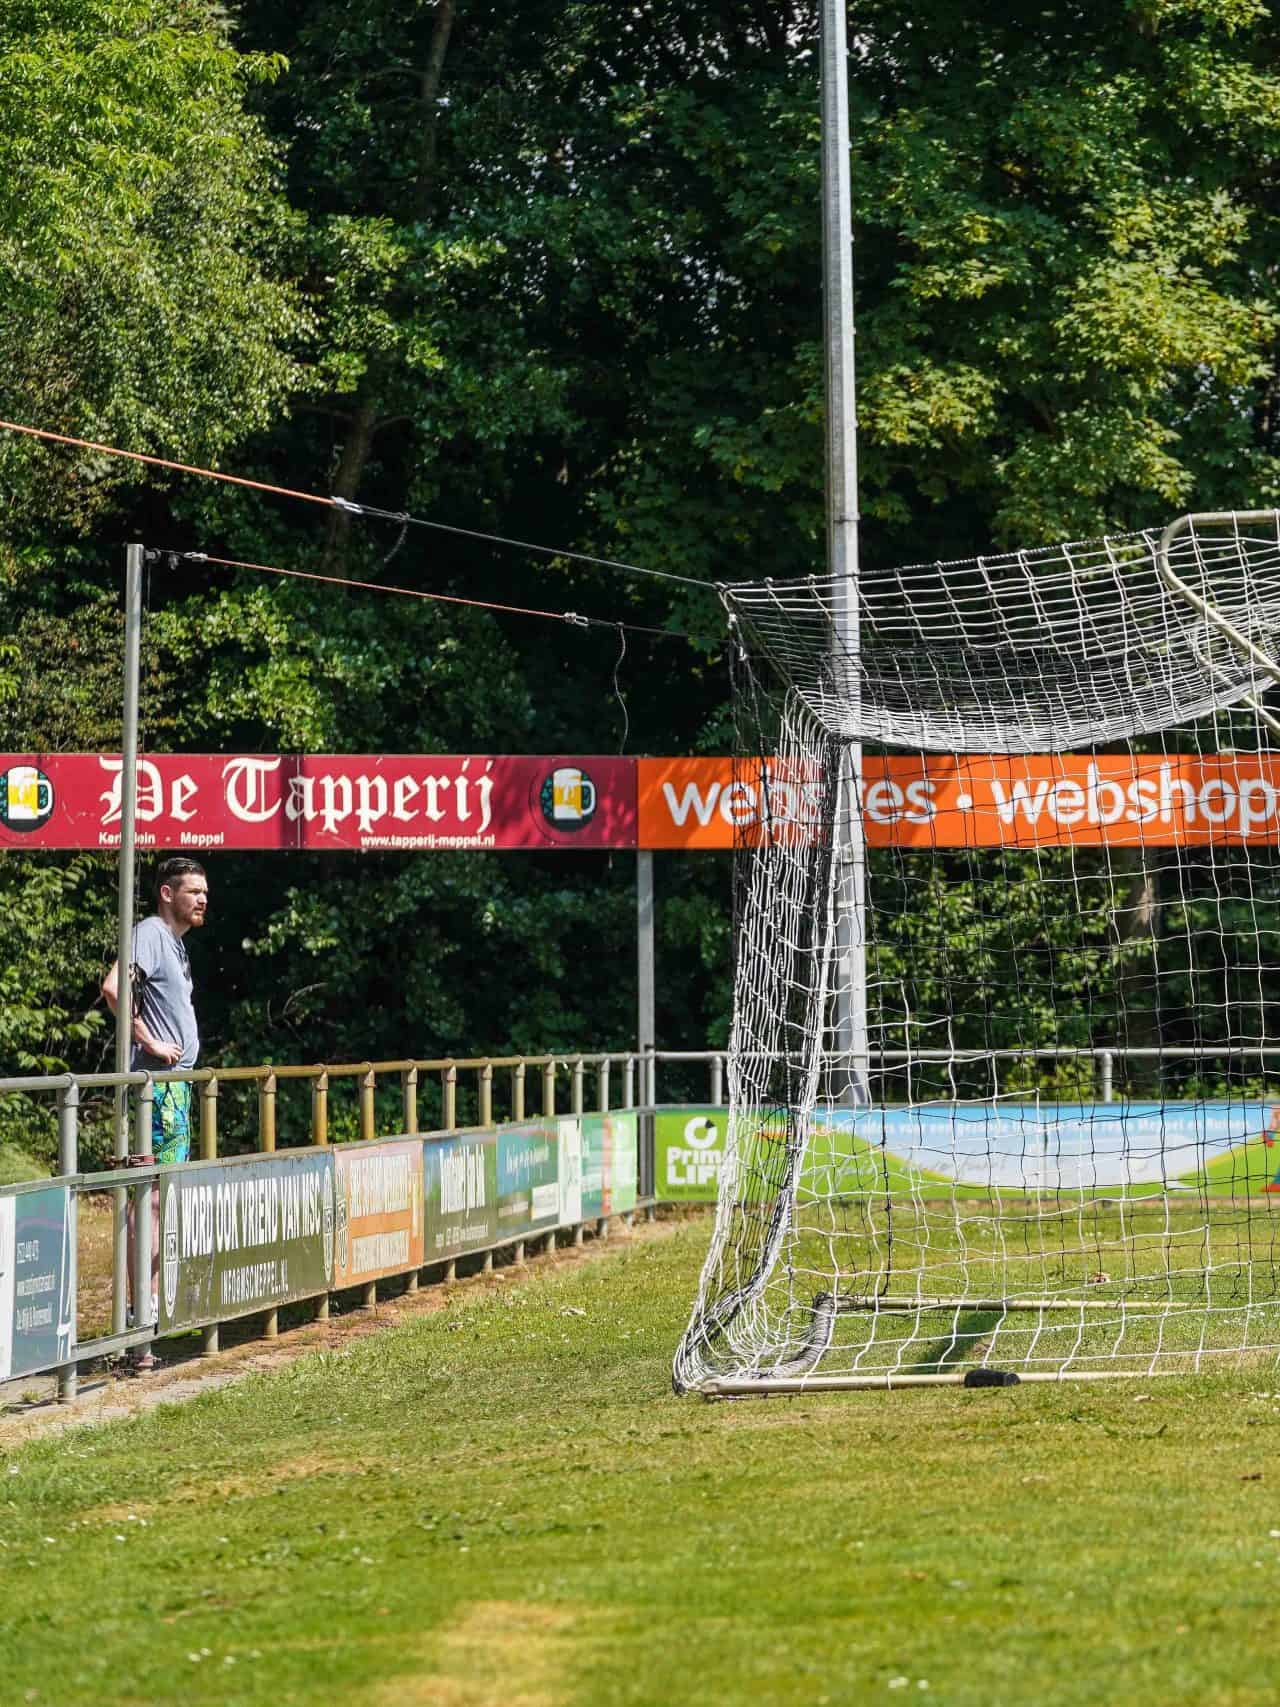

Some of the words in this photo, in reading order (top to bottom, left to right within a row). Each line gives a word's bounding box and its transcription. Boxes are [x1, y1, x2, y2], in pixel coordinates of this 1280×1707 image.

[99, 756, 199, 825] De
[221, 757, 495, 833] Tapperij
[662, 765, 936, 827] webses
[98, 831, 156, 846] Kerlein
[180, 831, 224, 847] Meppel
[361, 833, 496, 849] www.tapperij-meppel.nl
[667, 1146, 734, 1165] Prim
[667, 1165, 735, 1185] LIF
[182, 1184, 213, 1258] WORD
[216, 1181, 239, 1253] OOK
[241, 1176, 278, 1248] VRIEND
[281, 1174, 300, 1241] VAN
[302, 1171, 321, 1237] MSC
